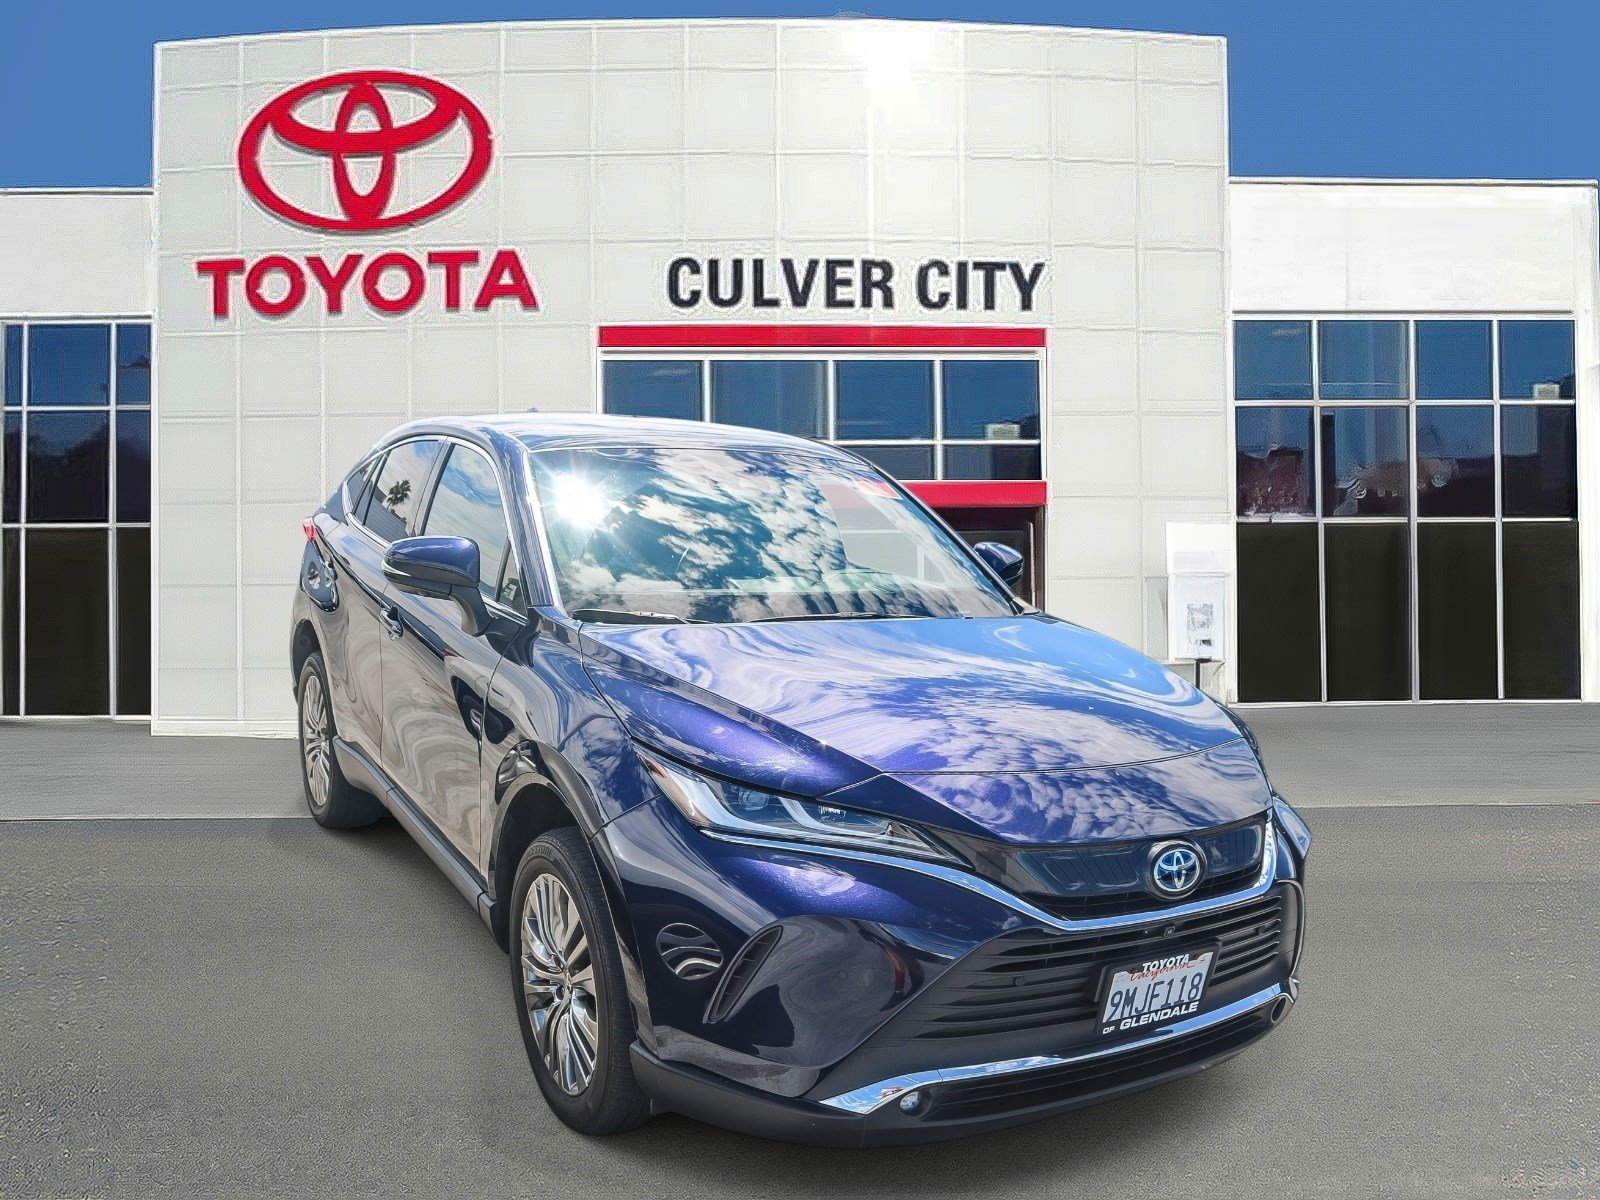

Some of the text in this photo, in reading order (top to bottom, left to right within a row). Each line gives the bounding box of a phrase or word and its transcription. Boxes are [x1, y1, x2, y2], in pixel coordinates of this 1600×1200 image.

[196, 250, 539, 318] TOYOTA
[668, 257, 1045, 311] CULVER CITY
[1142, 953, 1190, 974] TOYOTA
[1102, 1001, 1199, 1035] OF GLENDALE
[1106, 972, 1203, 1022] 9MJF118
